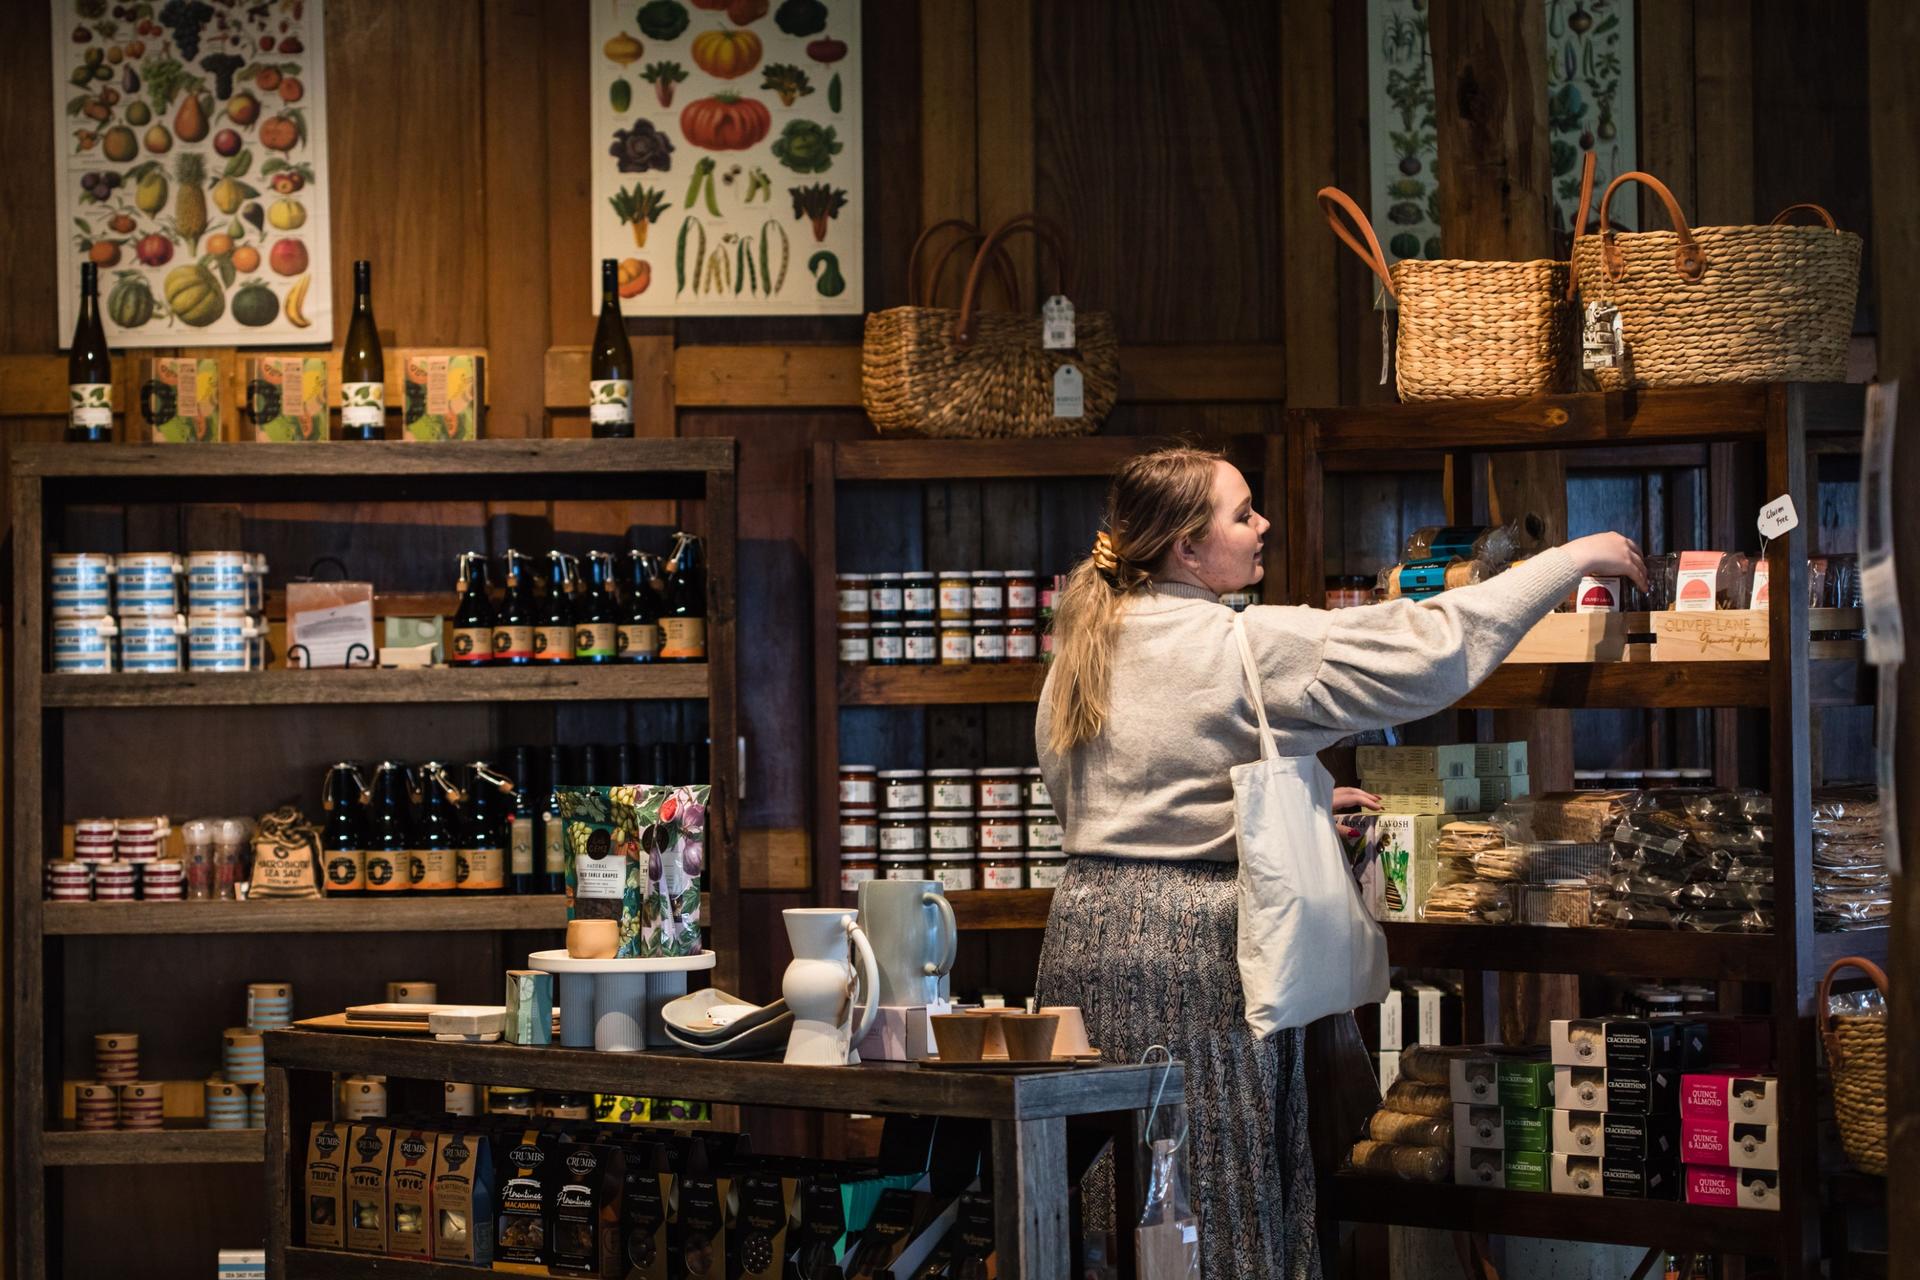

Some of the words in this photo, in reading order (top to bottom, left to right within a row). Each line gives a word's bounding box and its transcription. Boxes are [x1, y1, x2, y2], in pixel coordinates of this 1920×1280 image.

[1776, 515, 1789, 527] Free
[1664, 619, 1712, 632] OLIVER
[1717, 618, 1751, 631] LANE
[1379, 820, 1409, 828] LAVOSH
[1607, 1037, 1647, 1045] CRACKERTHINS
[1608, 1081, 1647, 1090] CRACKERTHINS
[1692, 1090, 1717, 1098] QUINCE
[1693, 1098, 1722, 1106] ALMOND
[1605, 1127, 1642, 1136] CRACKERTHINS
[1693, 1134, 1718, 1142] QUINCE
[1694, 1142, 1723, 1151] ALMOND
[509, 1151, 544, 1161] CRUMBS
[566, 1157, 597, 1168] CRUMBS
[312, 1171, 336, 1181] TRIPLE
[1604, 1171, 1641, 1180] CRACKERTHINS
[353, 1175, 379, 1186] YOYOS
[395, 1178, 423, 1190] YOYOS
[1699, 1179, 1725, 1187] QUINCE
[1700, 1187, 1731, 1195] ALMOND
[504, 1201, 540, 1210] MACADAMIA
